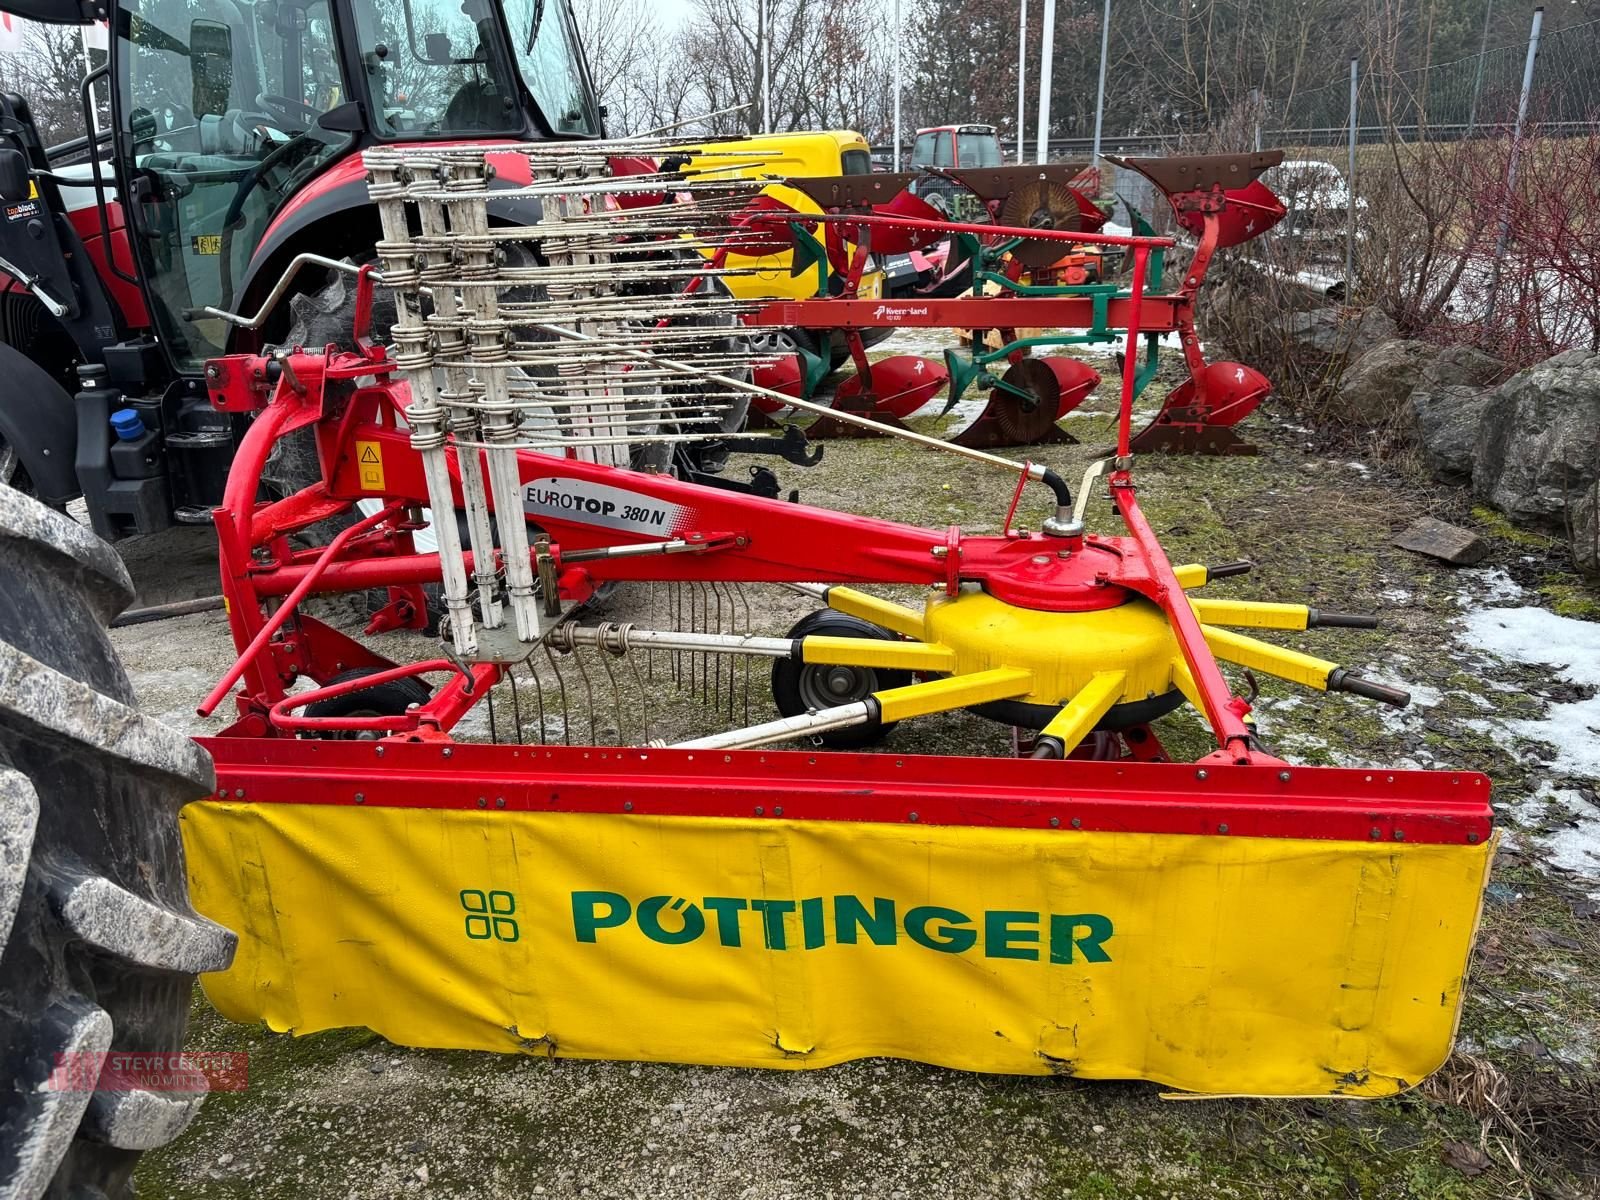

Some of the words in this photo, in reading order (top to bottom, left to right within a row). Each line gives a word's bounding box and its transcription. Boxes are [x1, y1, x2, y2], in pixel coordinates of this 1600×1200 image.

[886, 306, 928, 315] Kvernland
[526, 487, 616, 516] EUROTOP
[620, 505, 650, 523] 380
[650, 510, 666, 526] N
[571, 890, 1114, 966] PÖTTINGER
